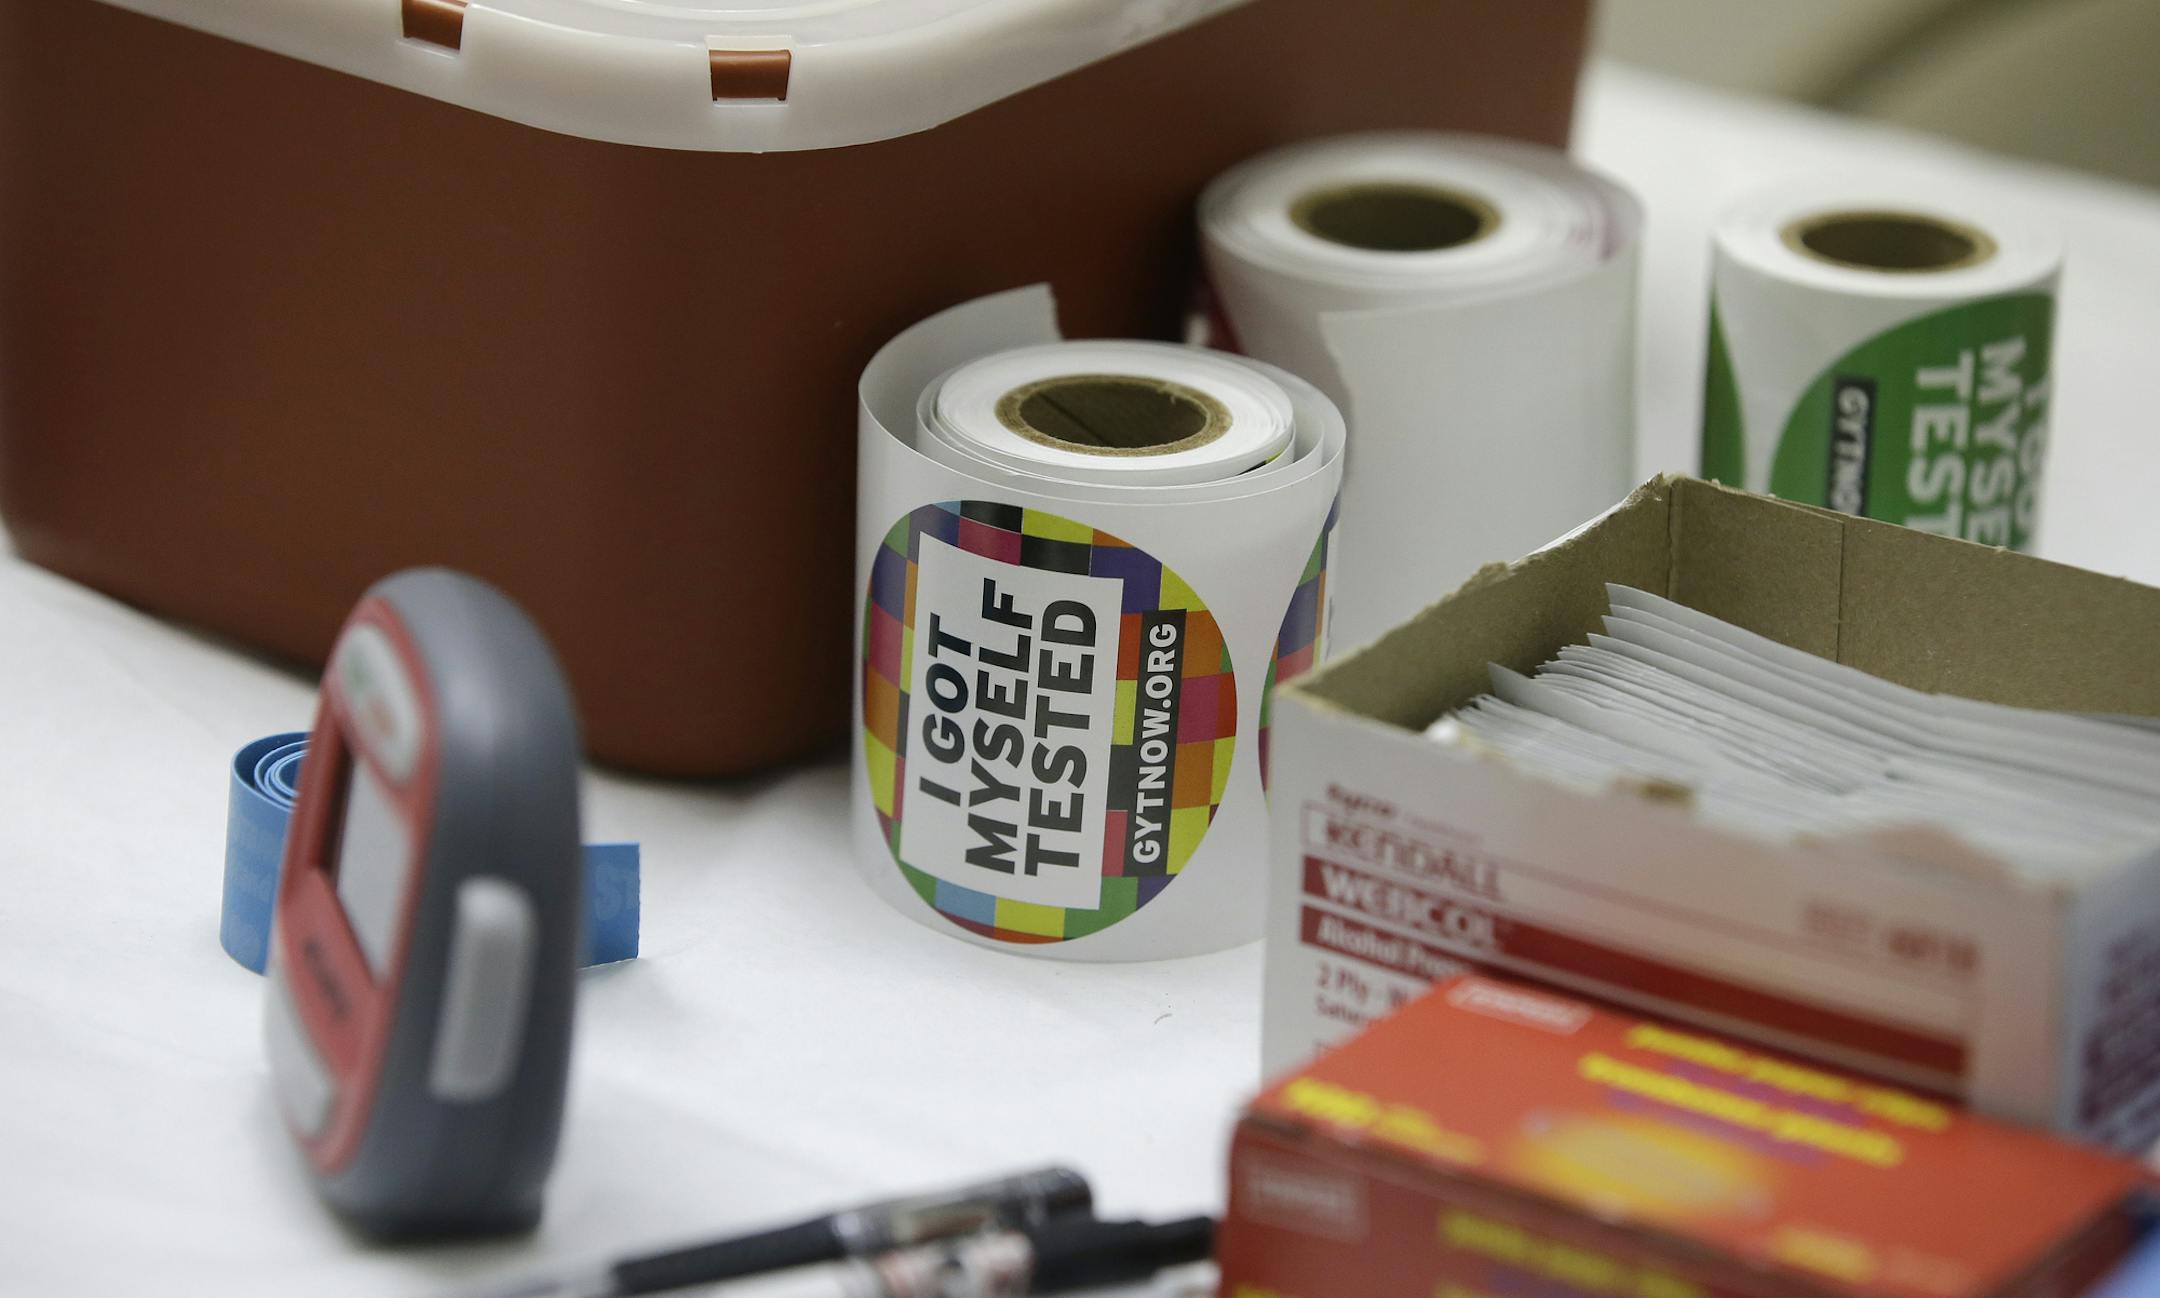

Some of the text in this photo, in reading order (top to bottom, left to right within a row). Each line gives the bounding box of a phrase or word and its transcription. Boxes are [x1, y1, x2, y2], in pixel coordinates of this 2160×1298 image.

[1905, 349, 1976, 538] TEST
[1967, 336, 2027, 548] MYSE
[919, 611, 974, 806] I GOT
[964, 577, 1033, 876] MYSELF
[1024, 599, 1098, 877] TESTED
[1132, 621, 1178, 865] GYTNOW.ORG
[1315, 914, 1403, 963] Alcohol
[1336, 966, 1369, 1004] Ply
